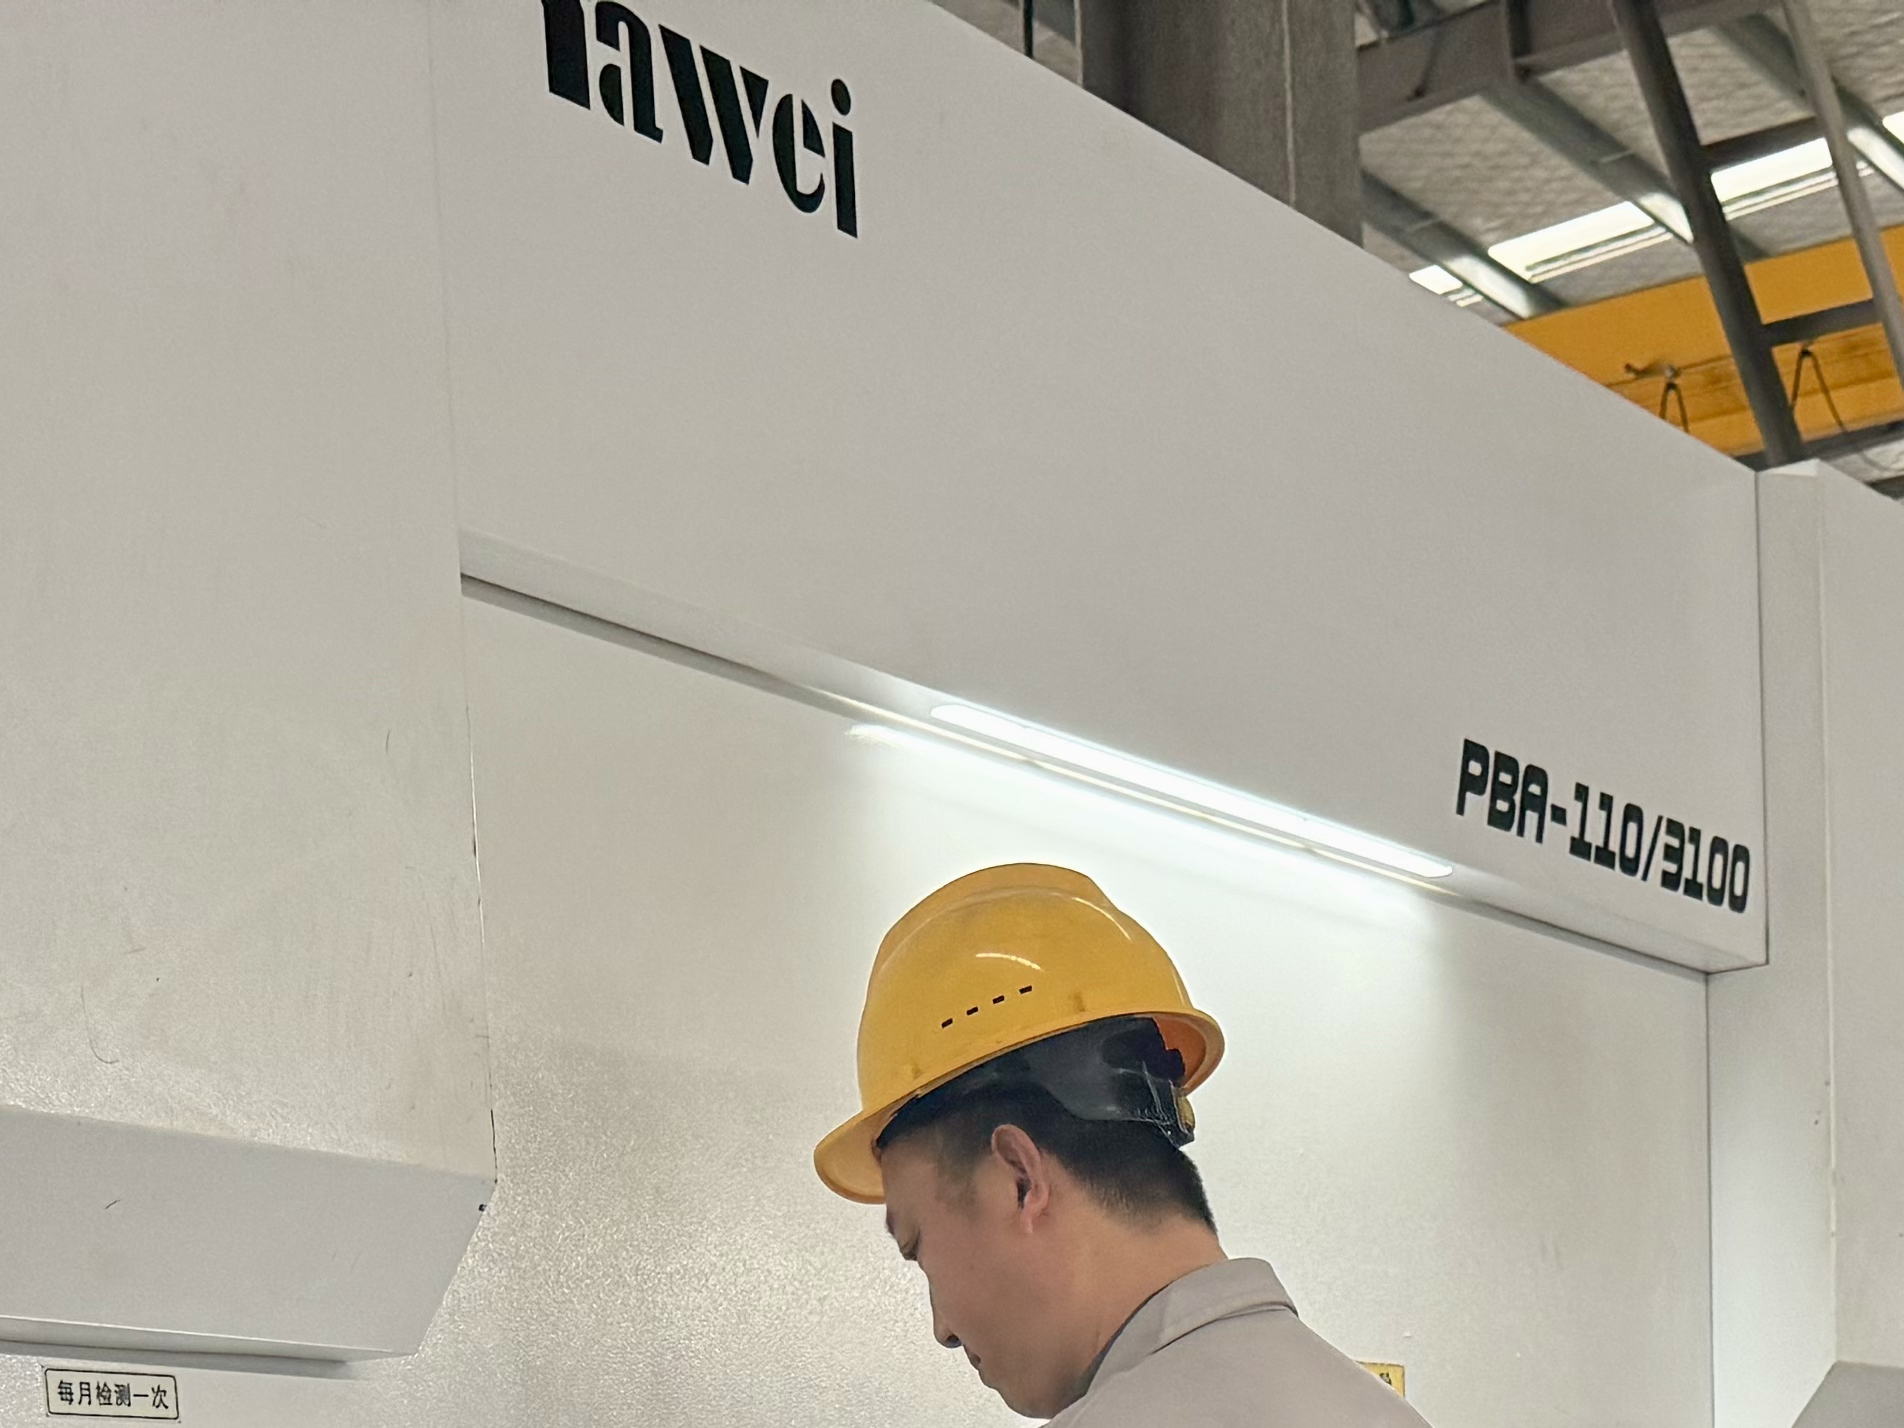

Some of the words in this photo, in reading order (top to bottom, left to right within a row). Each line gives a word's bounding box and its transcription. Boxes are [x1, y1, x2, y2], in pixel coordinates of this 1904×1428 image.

[1456, 738, 1751, 914] PBA-110/3100
[57, 1379, 170, 1410] 每月检测一次
